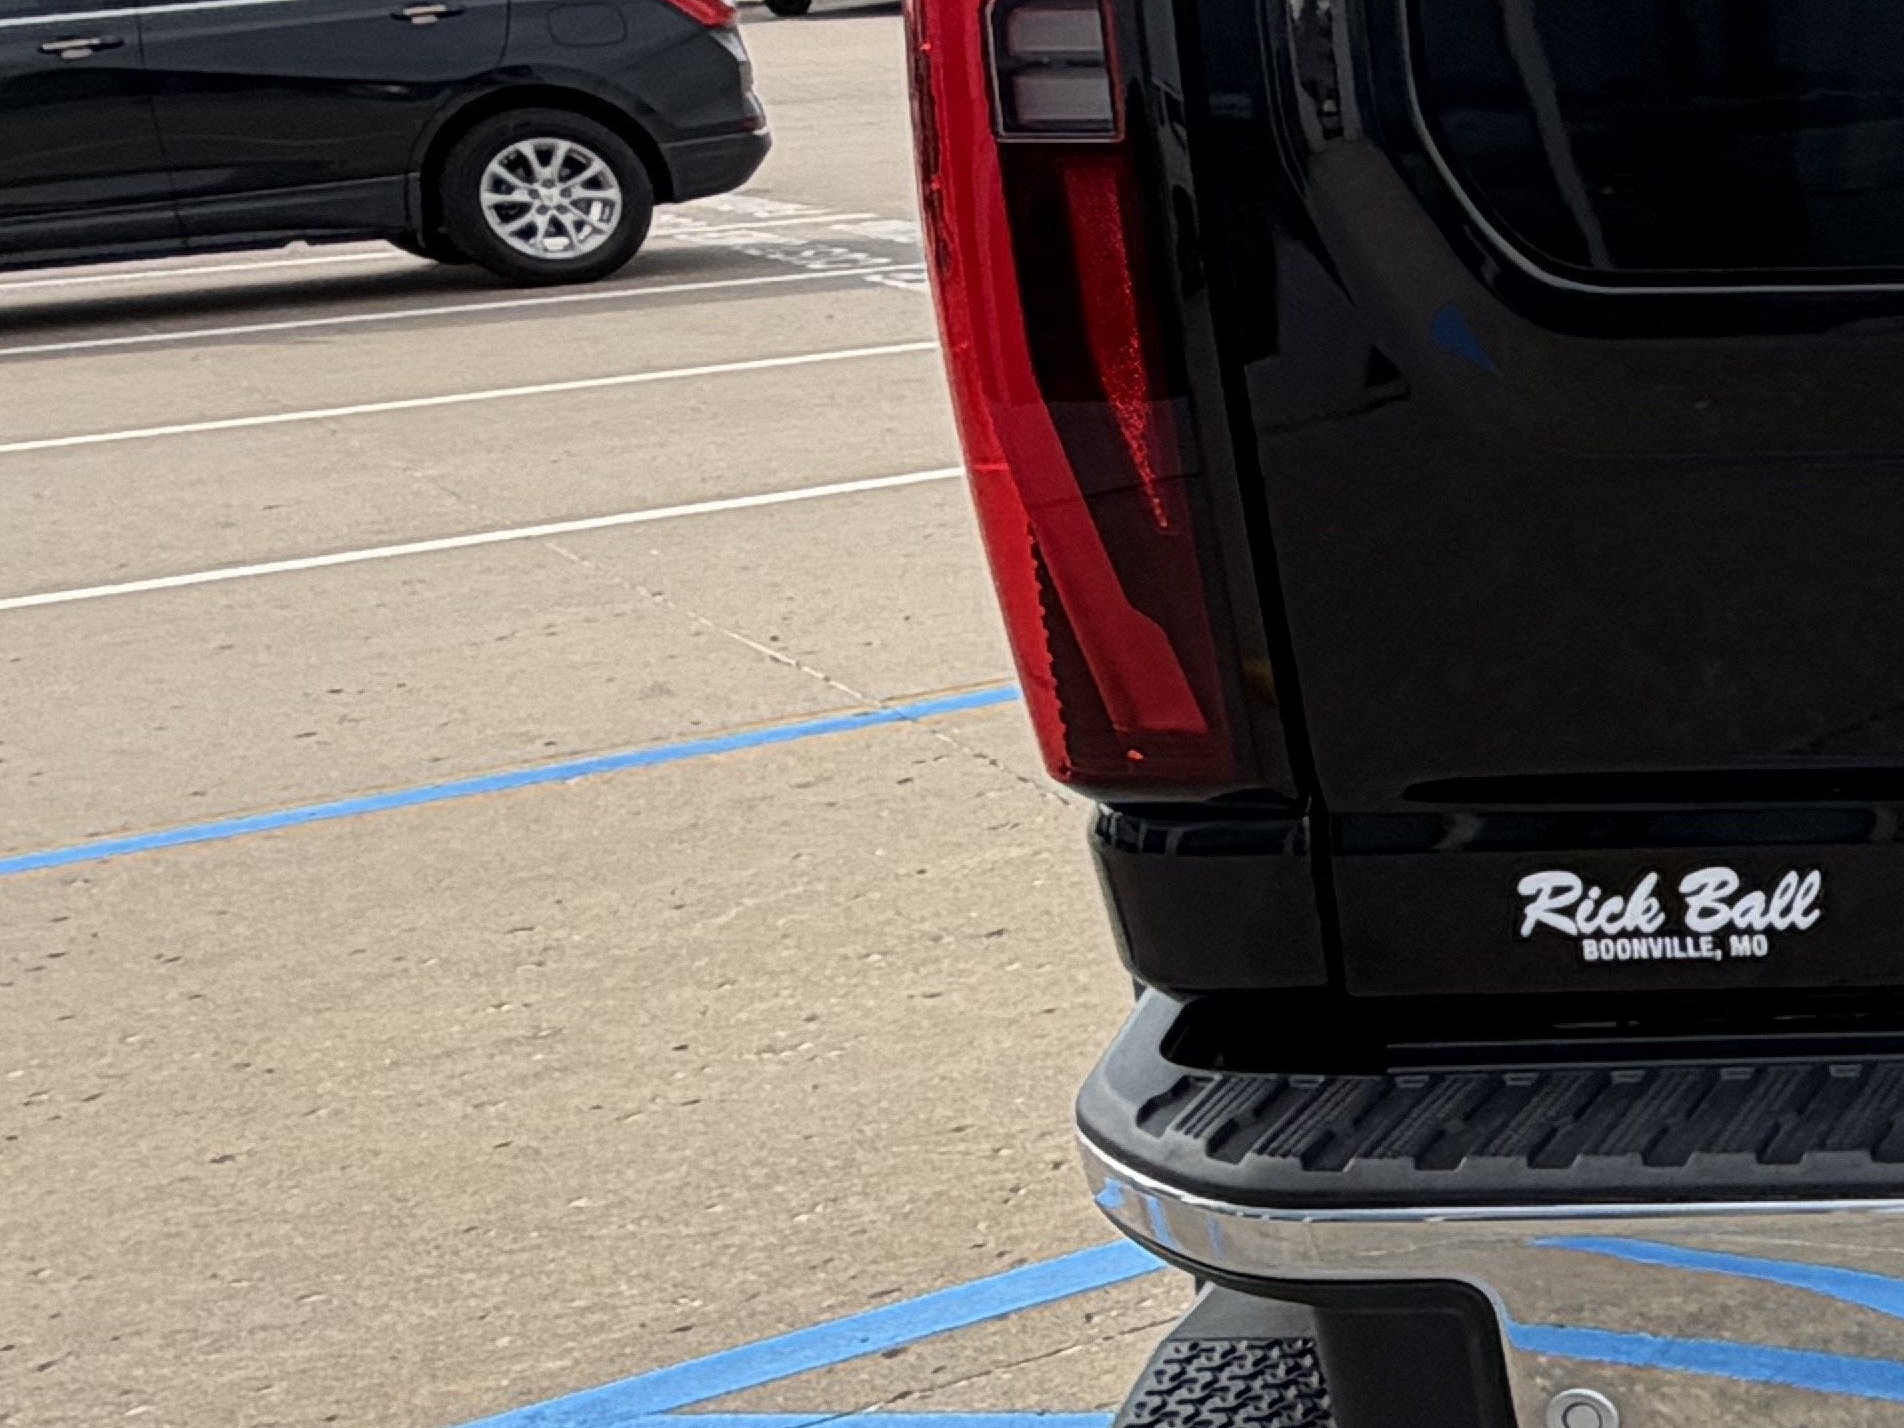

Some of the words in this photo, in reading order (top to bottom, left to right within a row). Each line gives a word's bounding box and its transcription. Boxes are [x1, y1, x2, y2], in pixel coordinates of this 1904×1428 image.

[1516, 869, 1666, 938] Rick
[1678, 866, 1822, 934] Ball
[1582, 937, 1723, 962] BOONVILLE,
[1730, 934, 1769, 958] MO
